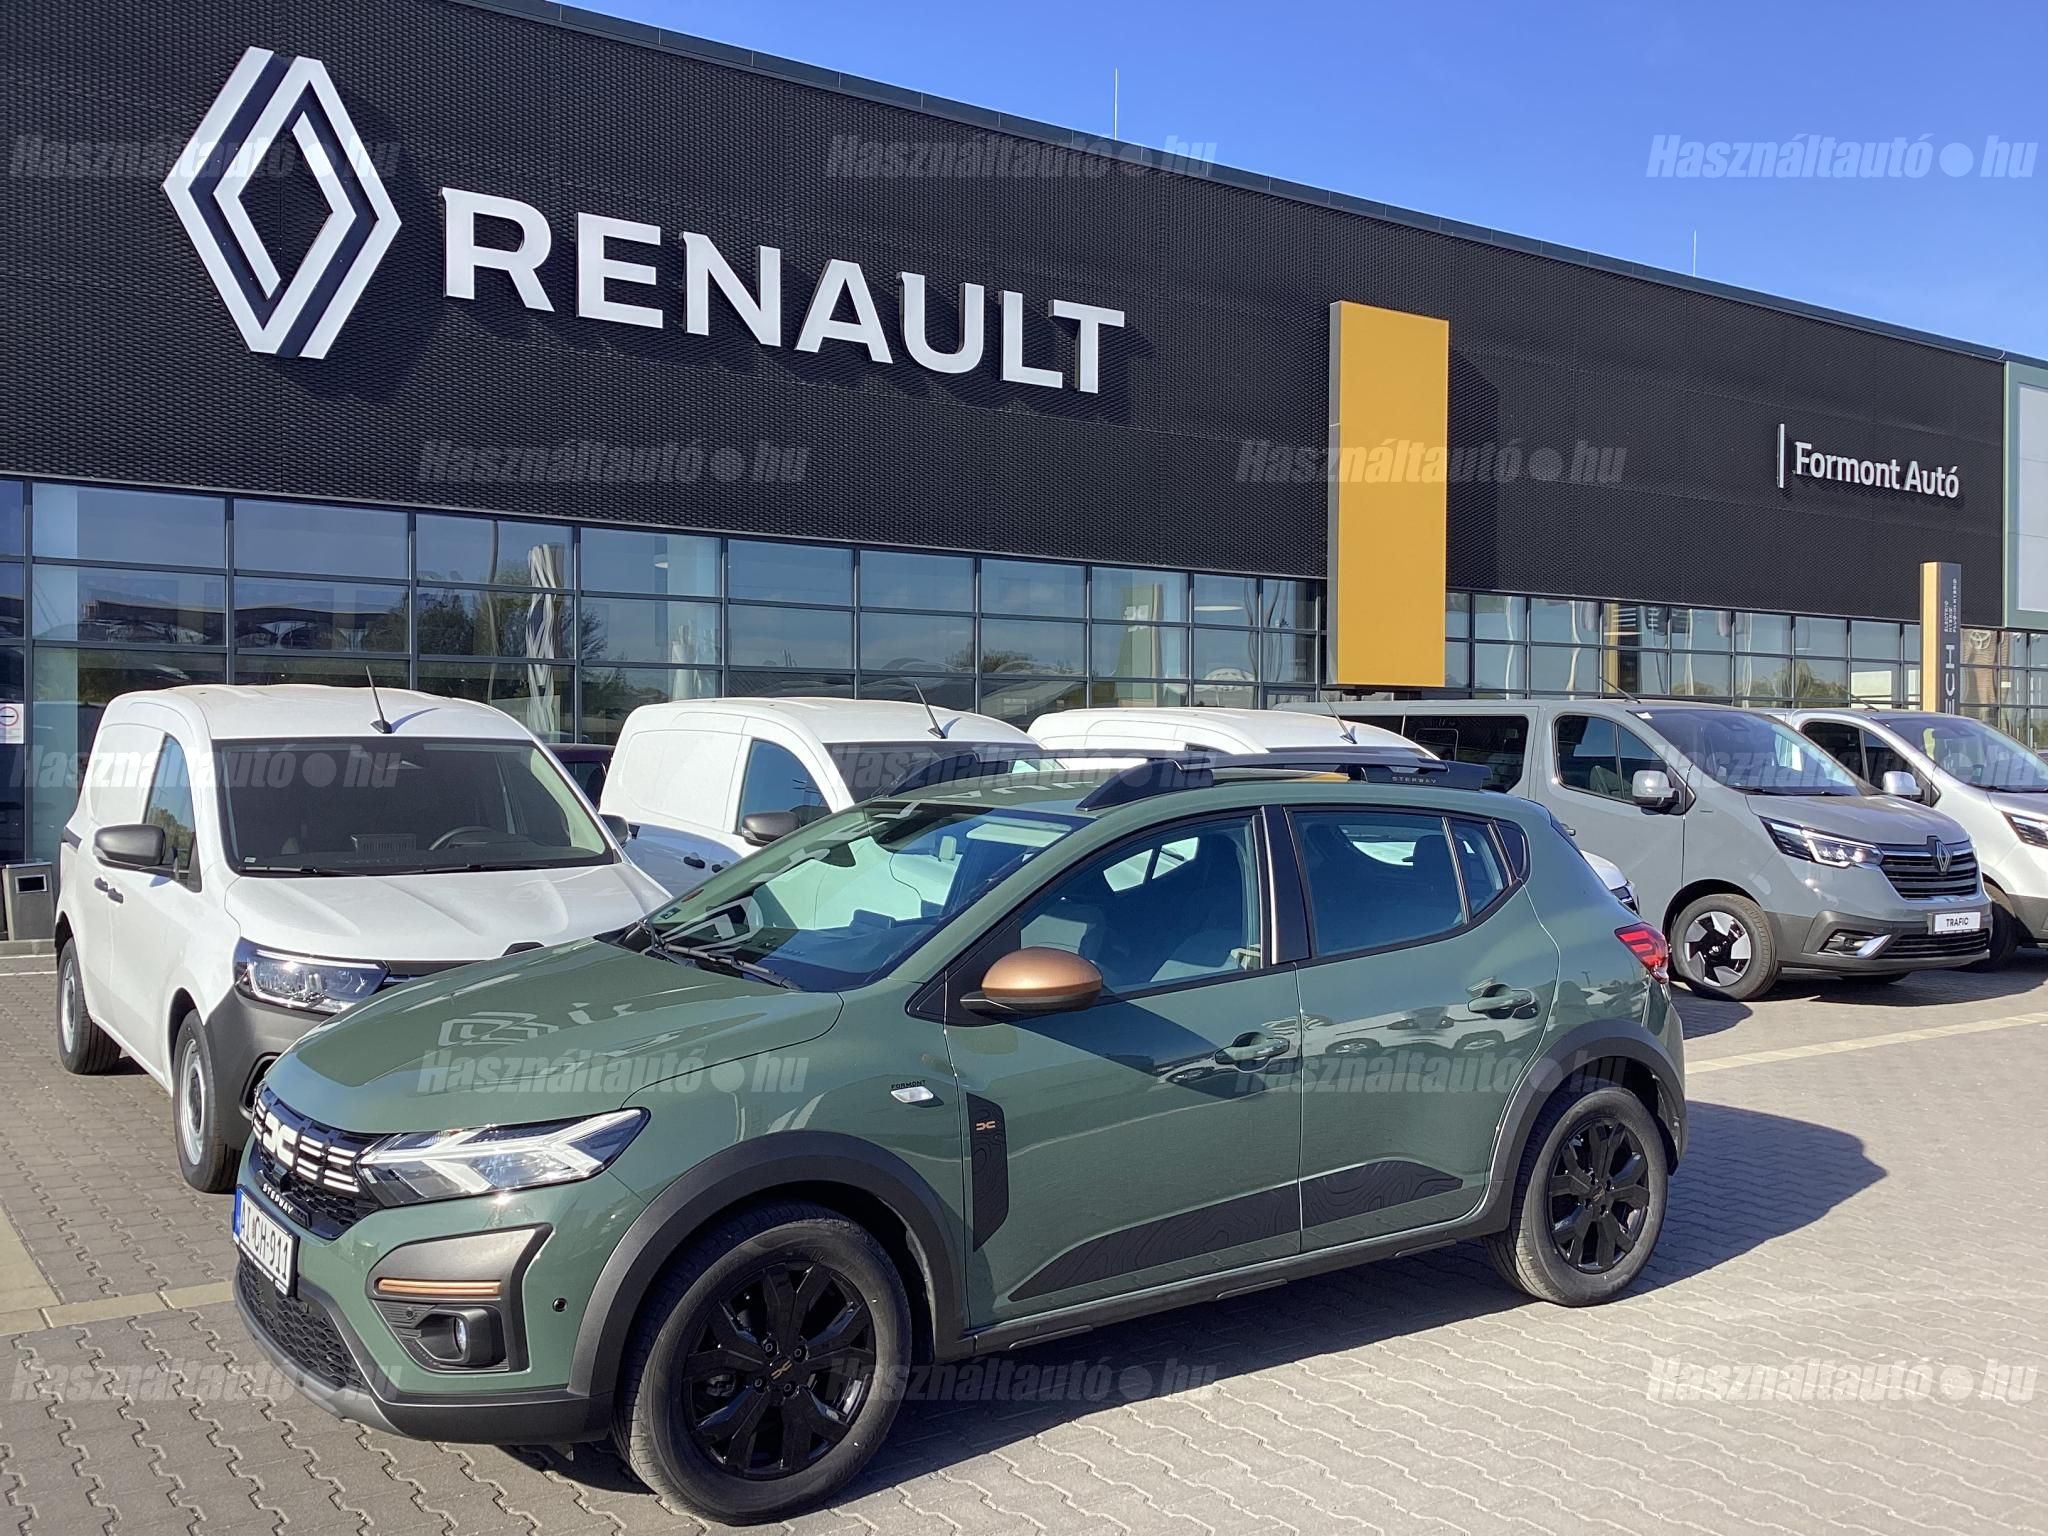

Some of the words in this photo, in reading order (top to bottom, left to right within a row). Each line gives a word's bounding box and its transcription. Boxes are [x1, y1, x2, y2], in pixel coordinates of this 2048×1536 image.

[438, 186, 1124, 393] RENAULT
[1794, 441, 1900, 490] Formont
[1904, 460, 1959, 498] Autó
[1945, 917, 1969, 927] TRAFIC
[891, 1080, 926, 1089] FORMONT
[262, 1183, 294, 1214] STEPWAY
